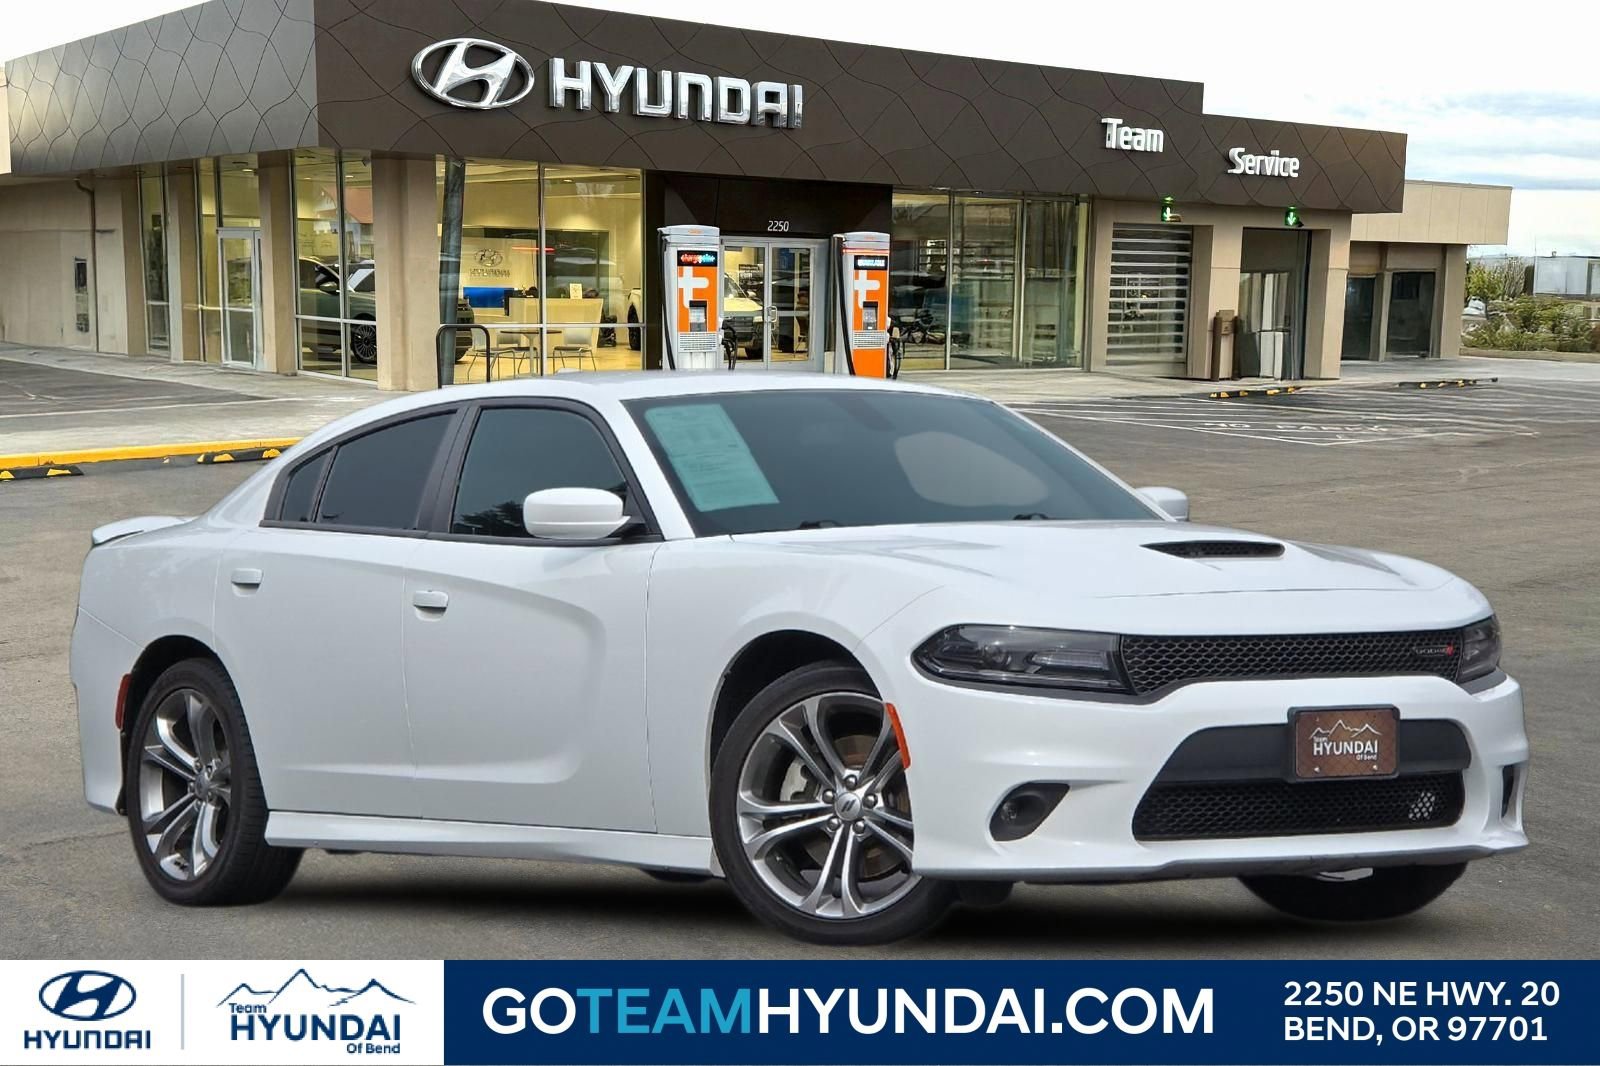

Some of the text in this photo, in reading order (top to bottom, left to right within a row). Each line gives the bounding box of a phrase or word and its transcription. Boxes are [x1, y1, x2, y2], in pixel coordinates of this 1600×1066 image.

[549, 57, 803, 129] HYUNDAI
[1101, 117, 1165, 153] Team
[1227, 147, 1300, 178] Service
[767, 220, 790, 232] 2250
[1312, 739, 1379, 756] HYUNDAI
